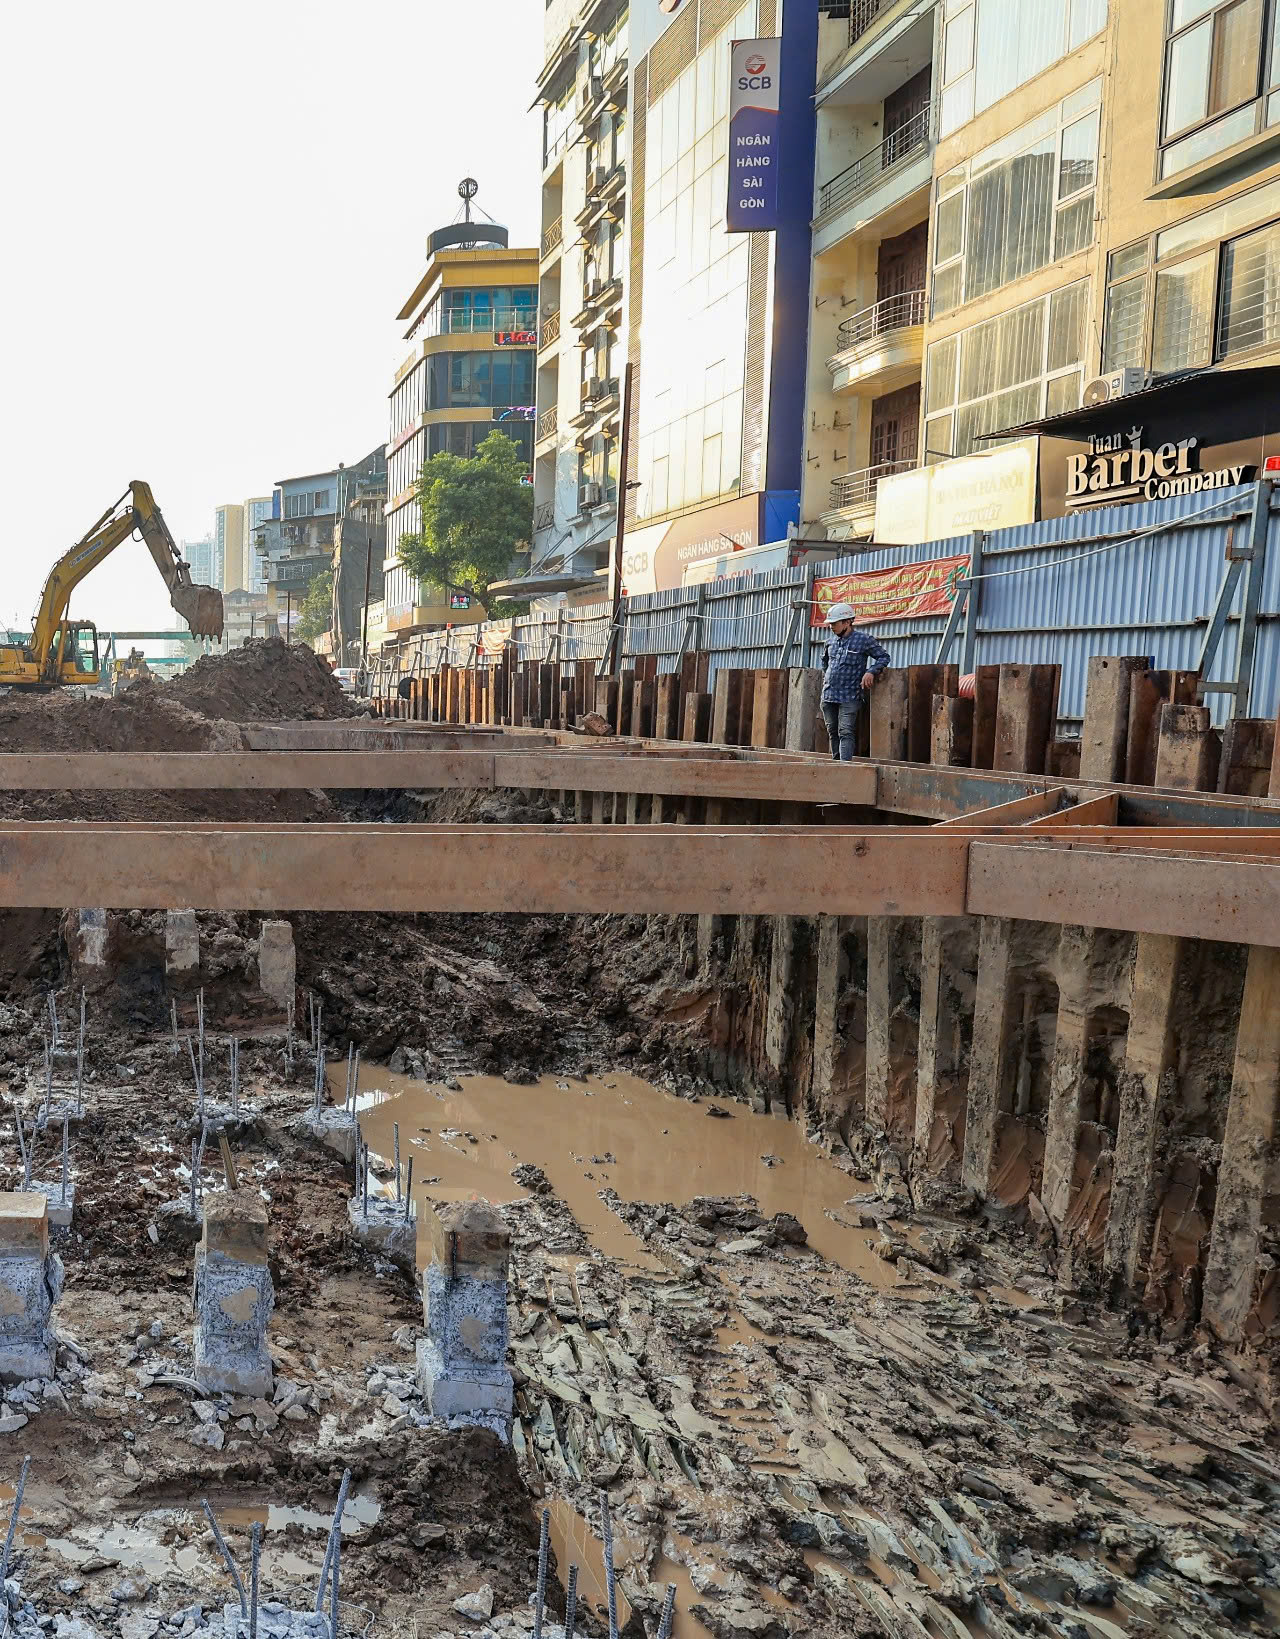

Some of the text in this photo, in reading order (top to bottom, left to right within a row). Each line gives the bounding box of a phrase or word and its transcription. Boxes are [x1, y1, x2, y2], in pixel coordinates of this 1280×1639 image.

[738, 76, 772, 90] SCB
[736, 133, 771, 146] NGÂN
[736, 155, 771, 168] HÀNG
[743, 175, 763, 188] SÀI
[739, 196, 765, 208] GÒN
[1087, 431, 1122, 456] Tuan
[1065, 436, 1199, 497] Barber
[1144, 464, 1245, 501] Company
[677, 543, 698, 561] NGÂN
[698, 538, 720, 556] HÀNG
[735, 529, 753, 546] GÒN
[626, 551, 649, 576] SCB
